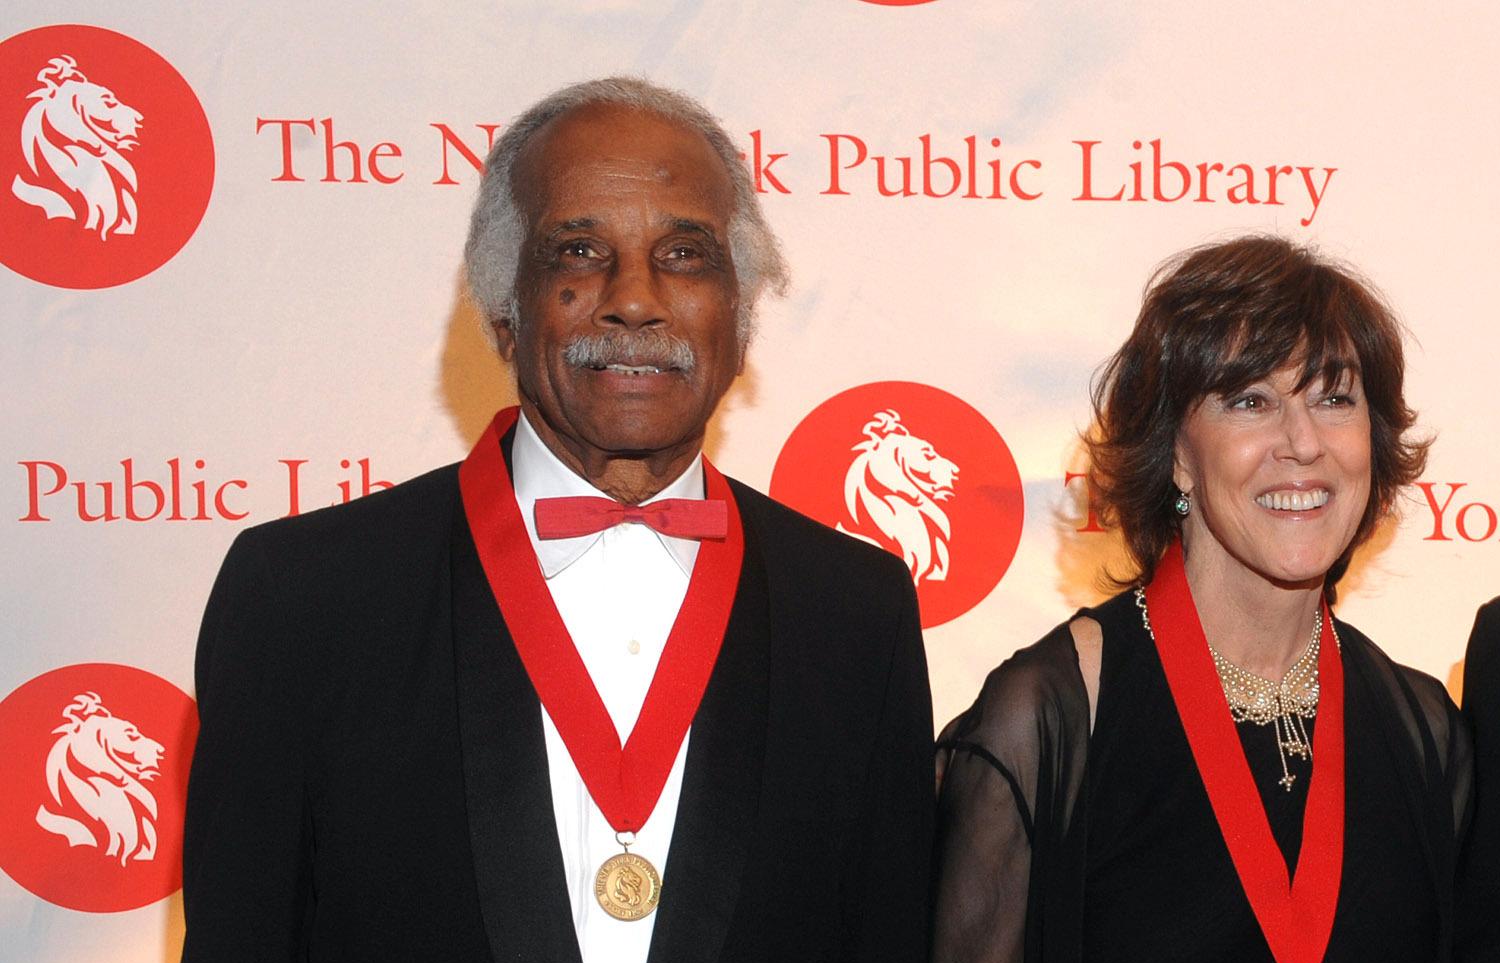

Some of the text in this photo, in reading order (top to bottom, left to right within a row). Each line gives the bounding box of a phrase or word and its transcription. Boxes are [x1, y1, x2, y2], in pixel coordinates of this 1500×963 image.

[256, 117, 405, 185] The
[820, 133, 1043, 201] Public
[1071, 138, 1338, 227] Library
[17, 457, 250, 522] Public
